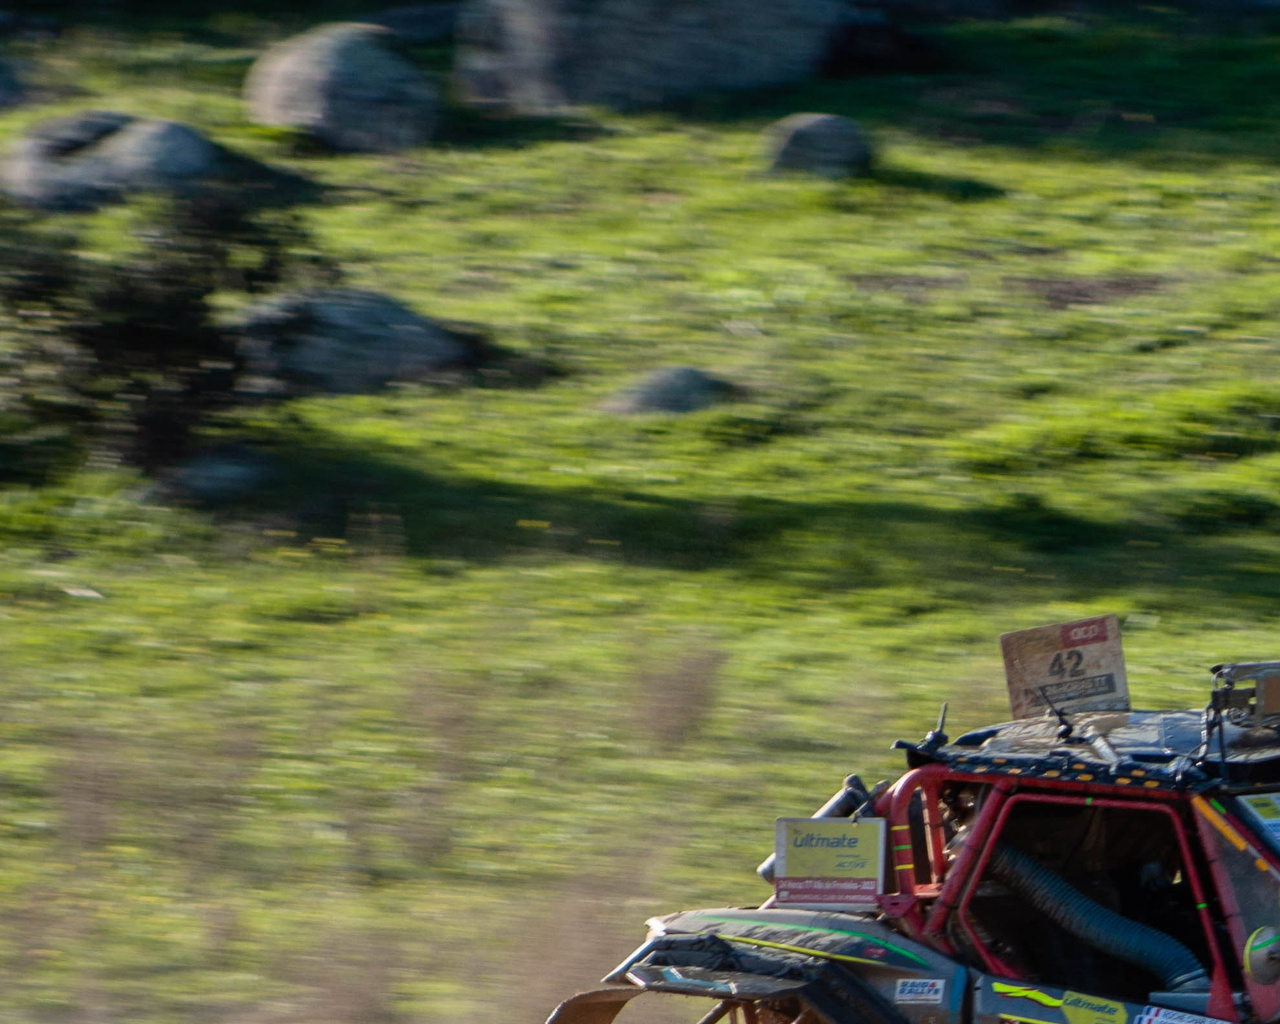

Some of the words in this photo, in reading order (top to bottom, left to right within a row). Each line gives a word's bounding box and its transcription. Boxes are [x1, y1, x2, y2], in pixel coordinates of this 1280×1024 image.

[1048, 650, 1086, 677] 42
[793, 833, 859, 848] ultimate
[1064, 996, 1118, 1015] ultimate
